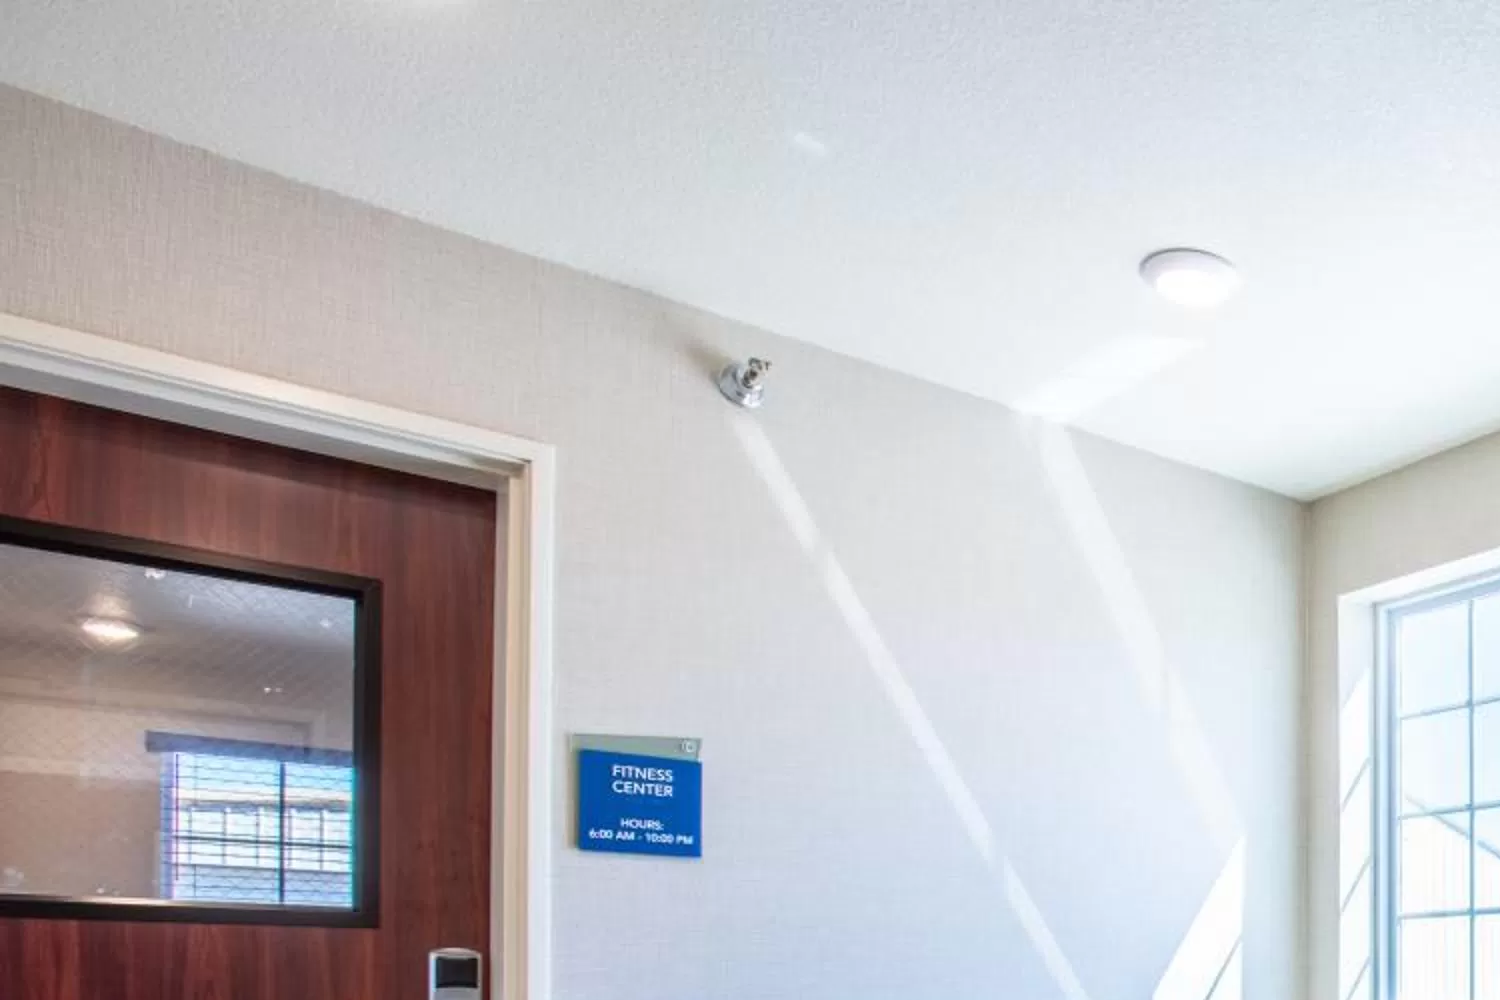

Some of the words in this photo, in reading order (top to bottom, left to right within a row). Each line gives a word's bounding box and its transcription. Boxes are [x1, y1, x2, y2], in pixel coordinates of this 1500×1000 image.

[612, 764, 673, 782] FITNESS
[612, 781, 673, 797] CENTER
[620, 818, 664, 831] HOURS:
[588, 828, 613, 840] 6:00
[615, 831, 635, 841] AM
[646, 833, 674, 844] 10:00
[676, 835, 694, 845] PM
